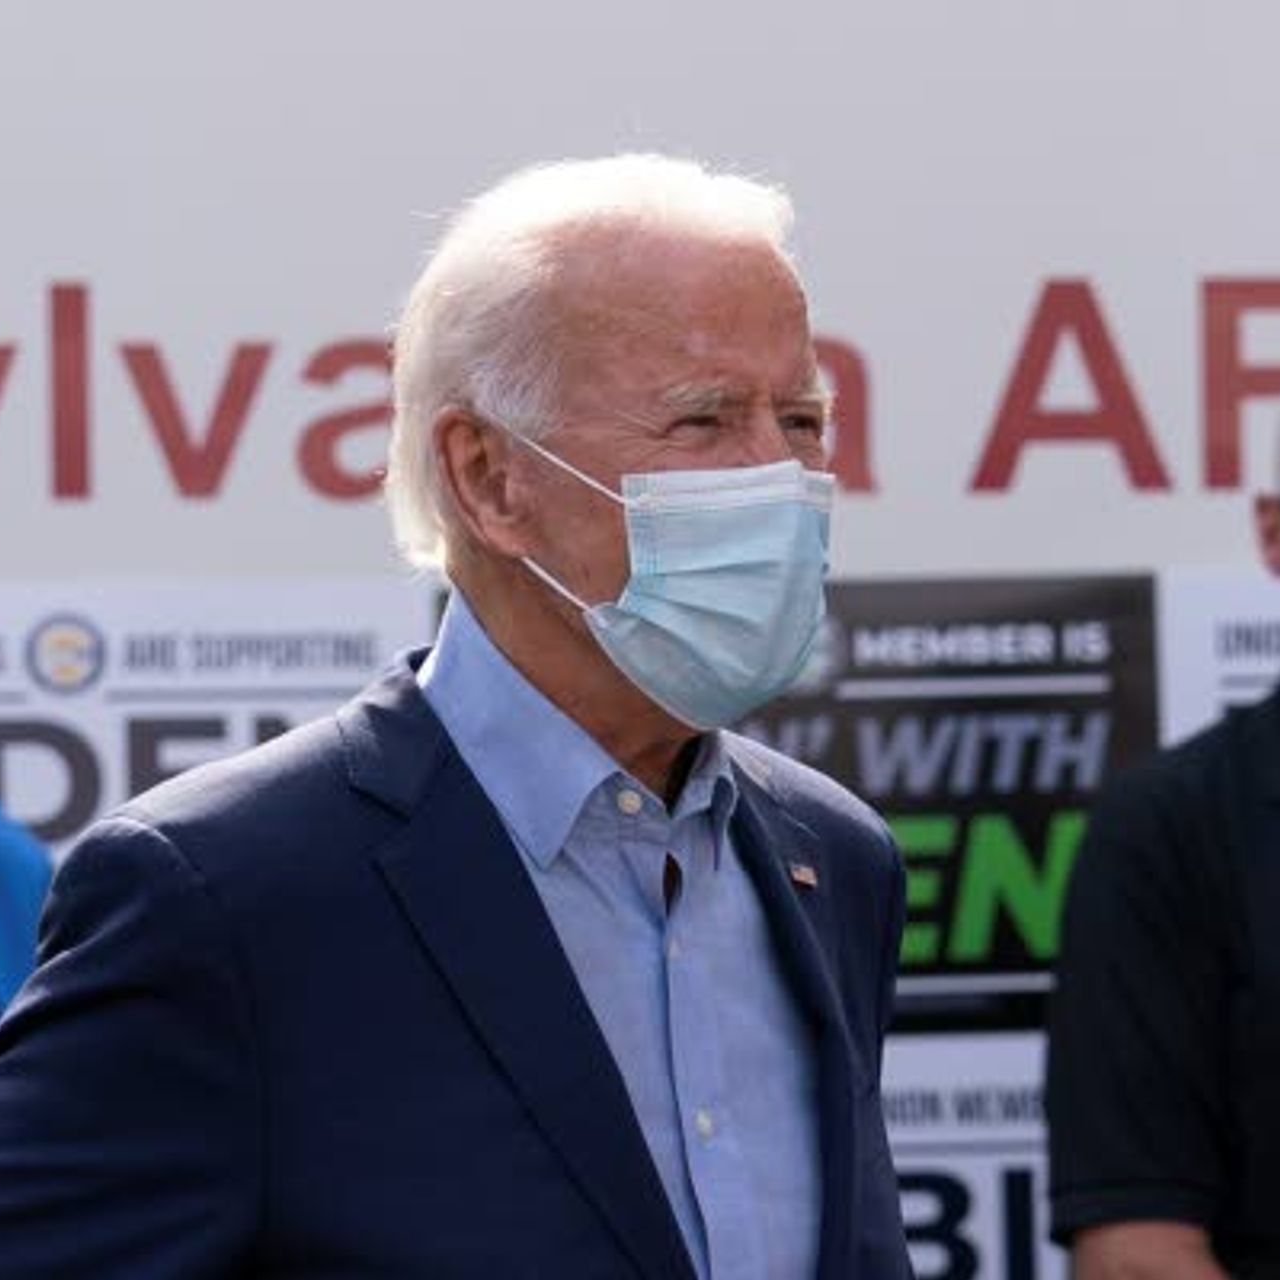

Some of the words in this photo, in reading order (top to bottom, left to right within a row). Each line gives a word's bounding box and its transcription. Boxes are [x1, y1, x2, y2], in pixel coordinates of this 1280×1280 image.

[854, 624, 1054, 666] MEMBER
[1063, 622, 1110, 662] IS
[855, 711, 1113, 794] WITH
